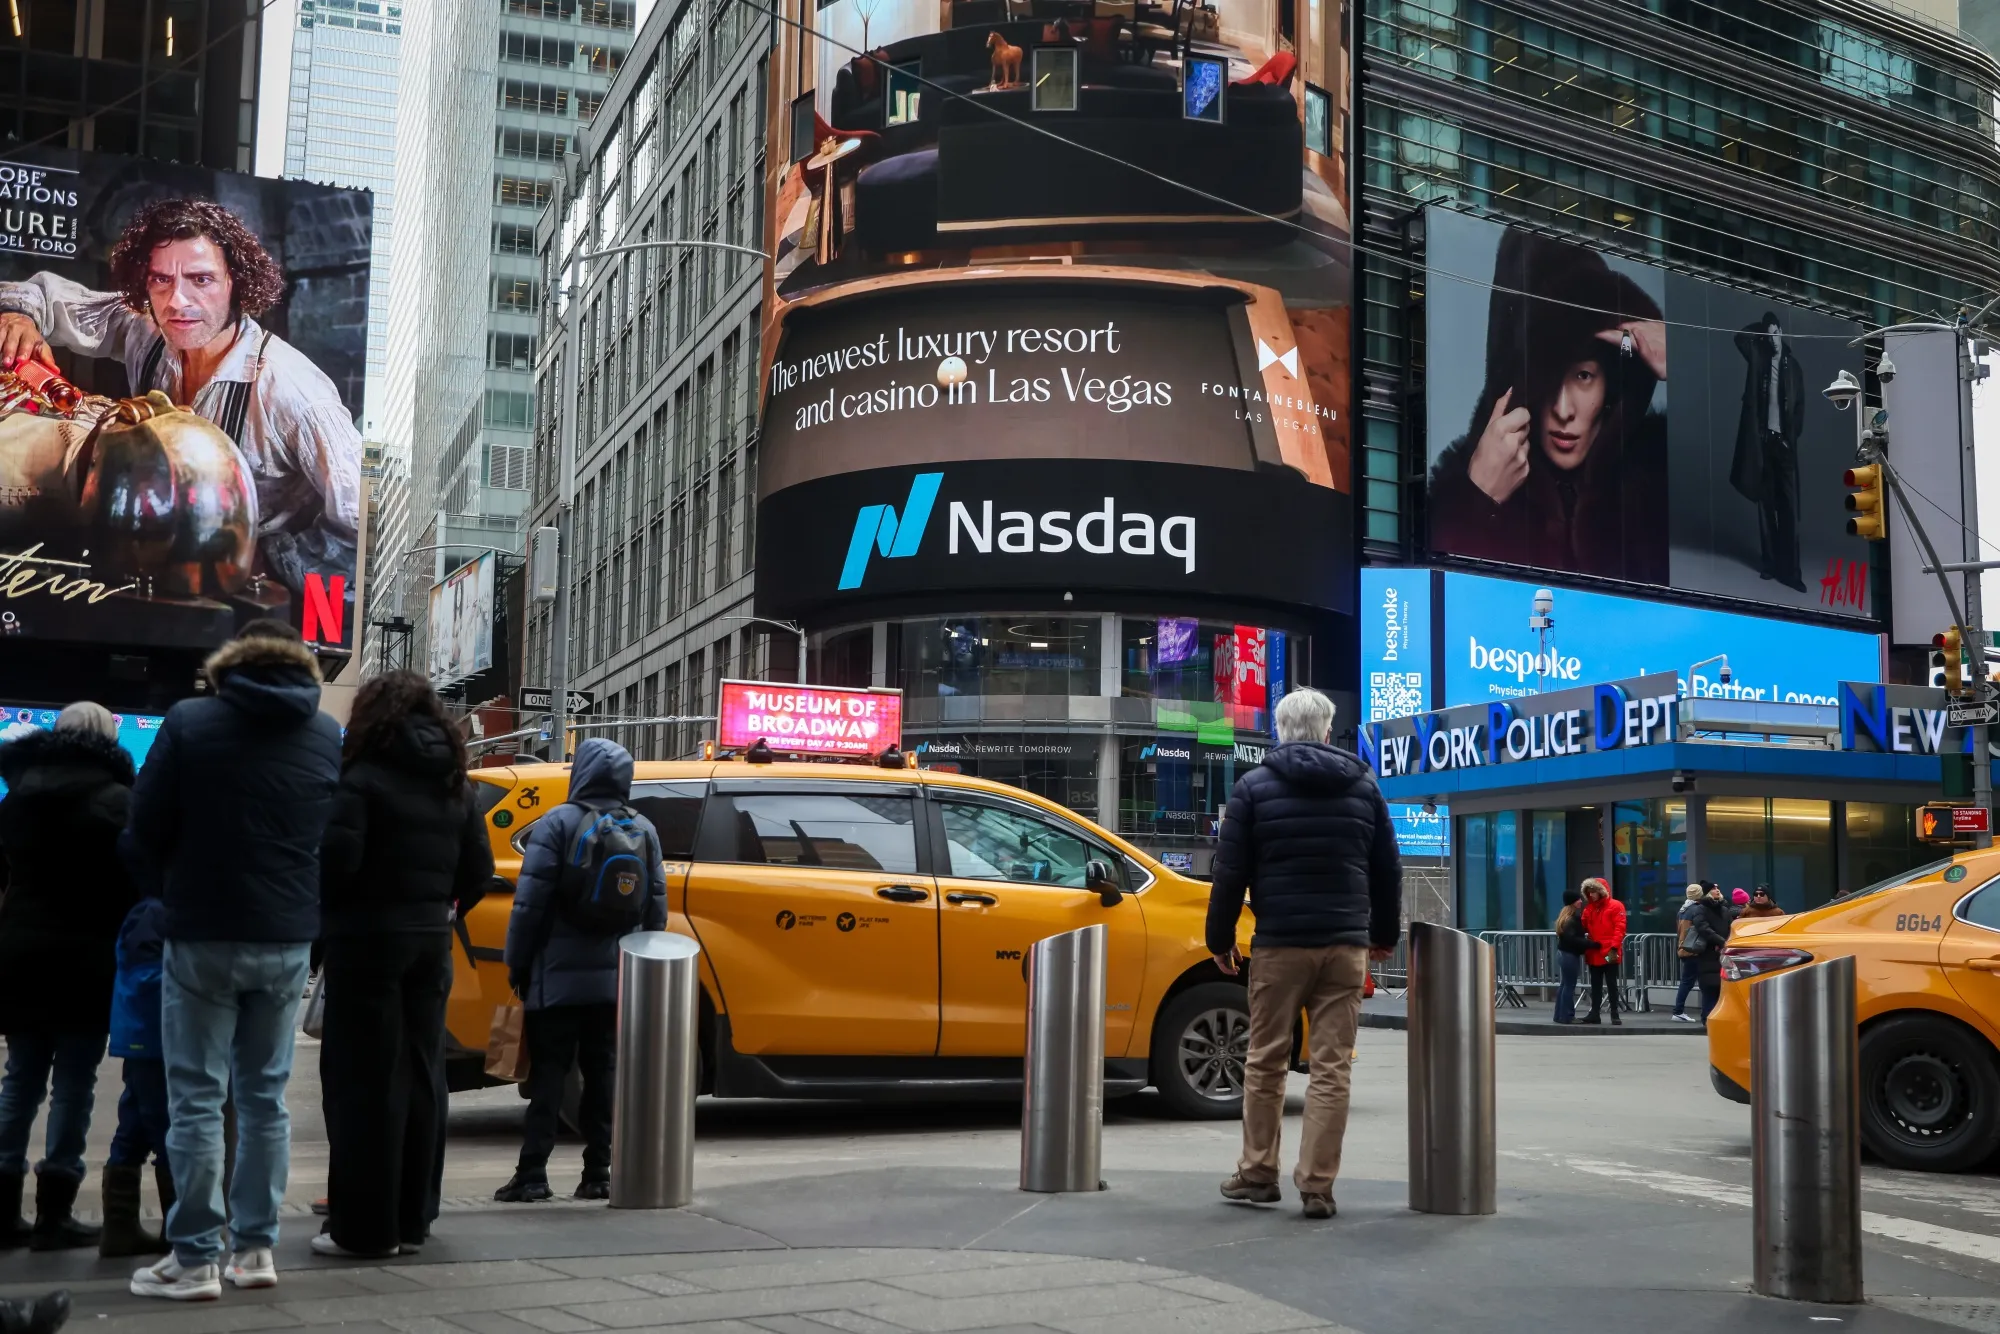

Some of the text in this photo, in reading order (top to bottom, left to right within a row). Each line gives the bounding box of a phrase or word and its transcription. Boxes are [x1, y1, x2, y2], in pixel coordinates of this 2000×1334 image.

[0, 183, 78, 207] ATIONS
[0, 207, 68, 239] URE
[32, 238, 77, 254] TORO
[770, 322, 1121, 397] The newest luxury resort
[795, 367, 1172, 431] and casino in Las Vegas
[1201, 383, 1337, 421] FONTAINEBLEAU
[1235, 410, 1317, 435] LAS VEGAS
[949, 497, 1196, 575] Nasdaq
[1819, 556, 1868, 612] H&M
[1382, 587, 1402, 661] bespoke
[1470, 636, 1581, 682] bespoke
[530, 695, 552, 706] ONE
[1488, 684, 1526, 697] Physical
[1692, 675, 1766, 701] Better
[748, 693, 877, 718] MUSEUM OF
[1838, 680, 1948, 755] NEW
[1951, 708, 1992, 720] ONE WAY
[747, 714, 879, 739] BROADWAY
[1358, 684, 1679, 777] NEW YORK POLICE DEPT
[781, 737, 806, 746] EVERY
[807, 739, 824, 748] DAY
[825, 740, 836, 748] AT
[929, 743, 1072, 755] Nasdaq REWRITE TOMORROW
[1157, 747, 1190, 760] Nasdaq
[996, 950, 1021, 960] NYC
